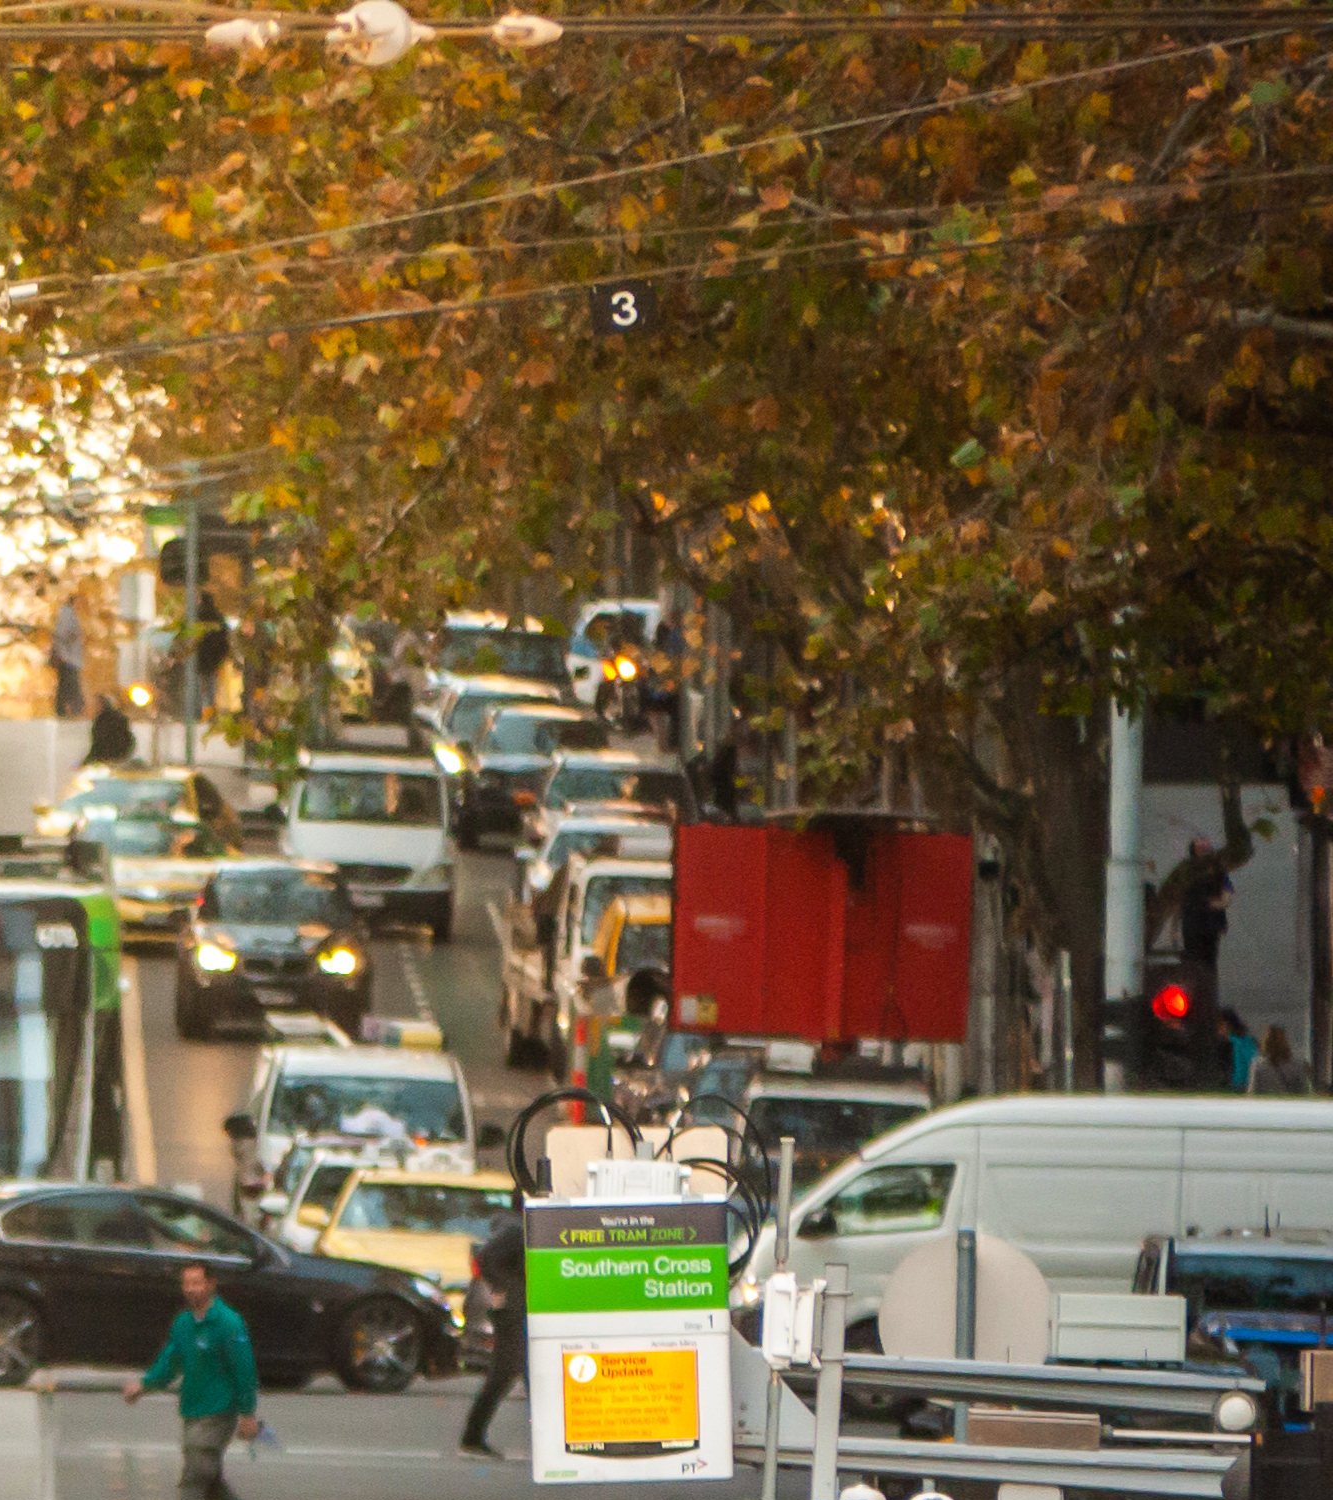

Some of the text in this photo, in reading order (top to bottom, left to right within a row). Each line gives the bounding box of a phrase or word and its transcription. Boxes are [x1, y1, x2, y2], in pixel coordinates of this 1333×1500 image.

[611, 290, 638, 327] 3
[570, 1228, 685, 1243] FREE TRAM ZONE
[560, 1255, 712, 1277] Southern Cross
[644, 1278, 713, 1298] Station
[707, 1314, 714, 1329] 1
[601, 1355, 647, 1366] Service
[601, 1367, 654, 1379] Updates
